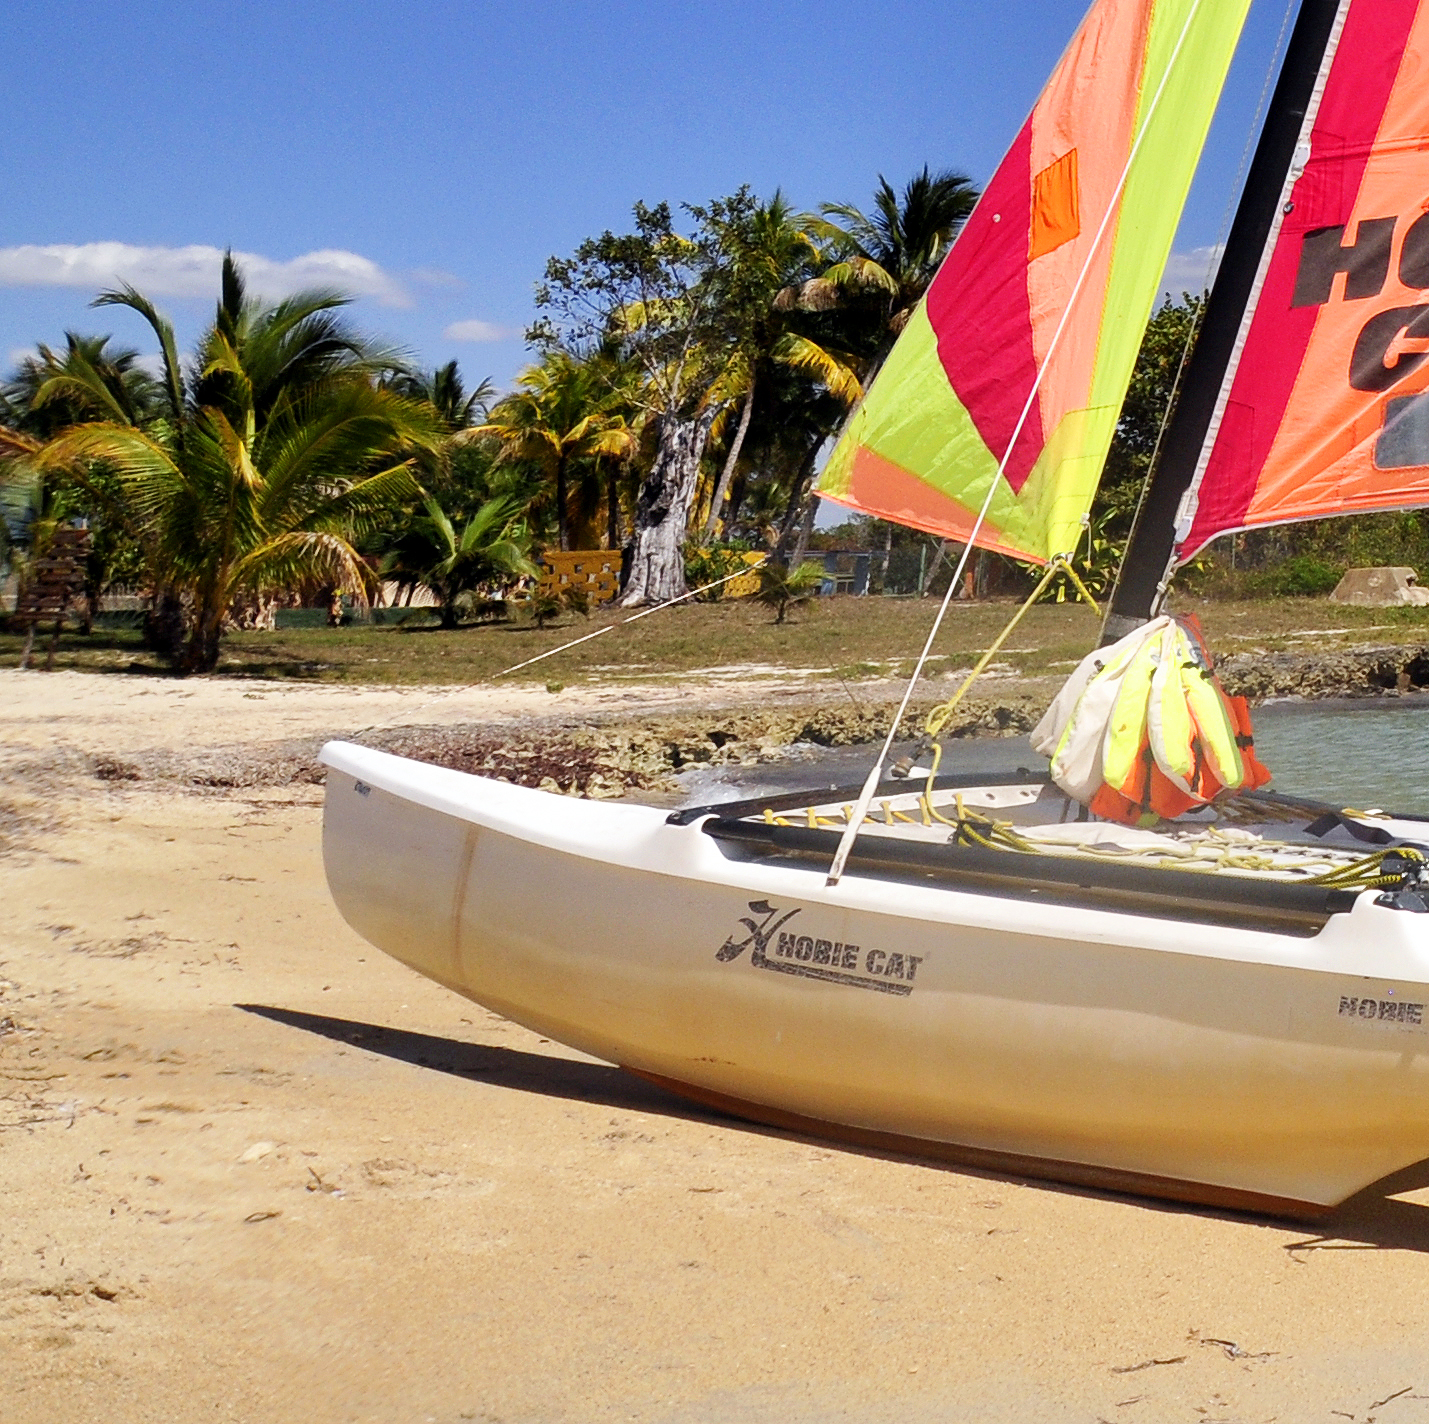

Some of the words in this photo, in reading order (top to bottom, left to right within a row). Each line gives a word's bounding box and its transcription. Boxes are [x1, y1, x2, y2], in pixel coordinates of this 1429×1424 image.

[775, 931, 860, 970] HOBIE
[865, 948, 924, 981] CAT
[1338, 995, 1424, 1025] HOBIE
